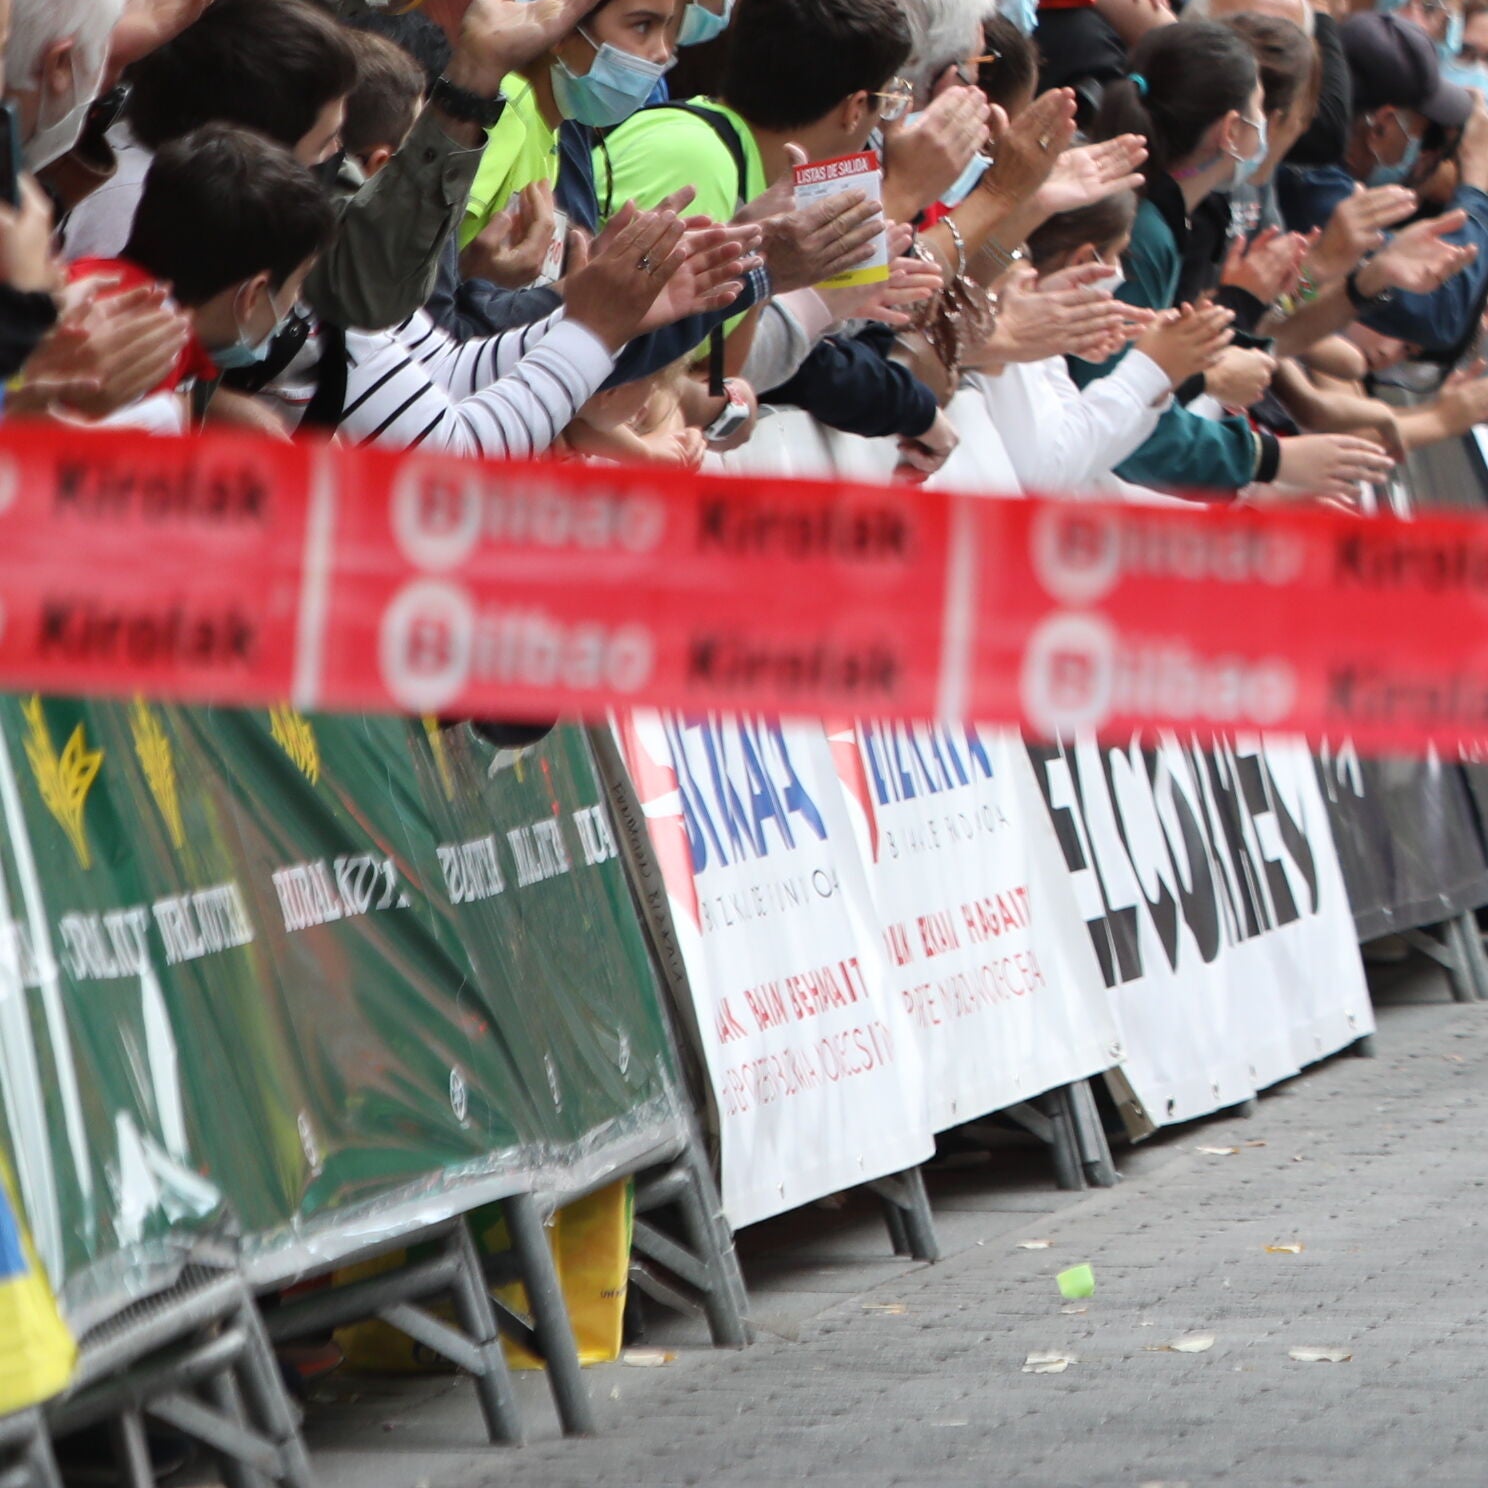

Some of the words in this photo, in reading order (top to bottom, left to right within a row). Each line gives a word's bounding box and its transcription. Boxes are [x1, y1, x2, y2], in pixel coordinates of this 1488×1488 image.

[796, 165, 826, 184] LISTAS
[826, 163, 838, 179] DE
[837, 156, 869, 178] SALIDA
[390, 458, 666, 572] Bilbao
[380, 577, 655, 711] Bilbao
[1020, 611, 1294, 744] Bilbao
